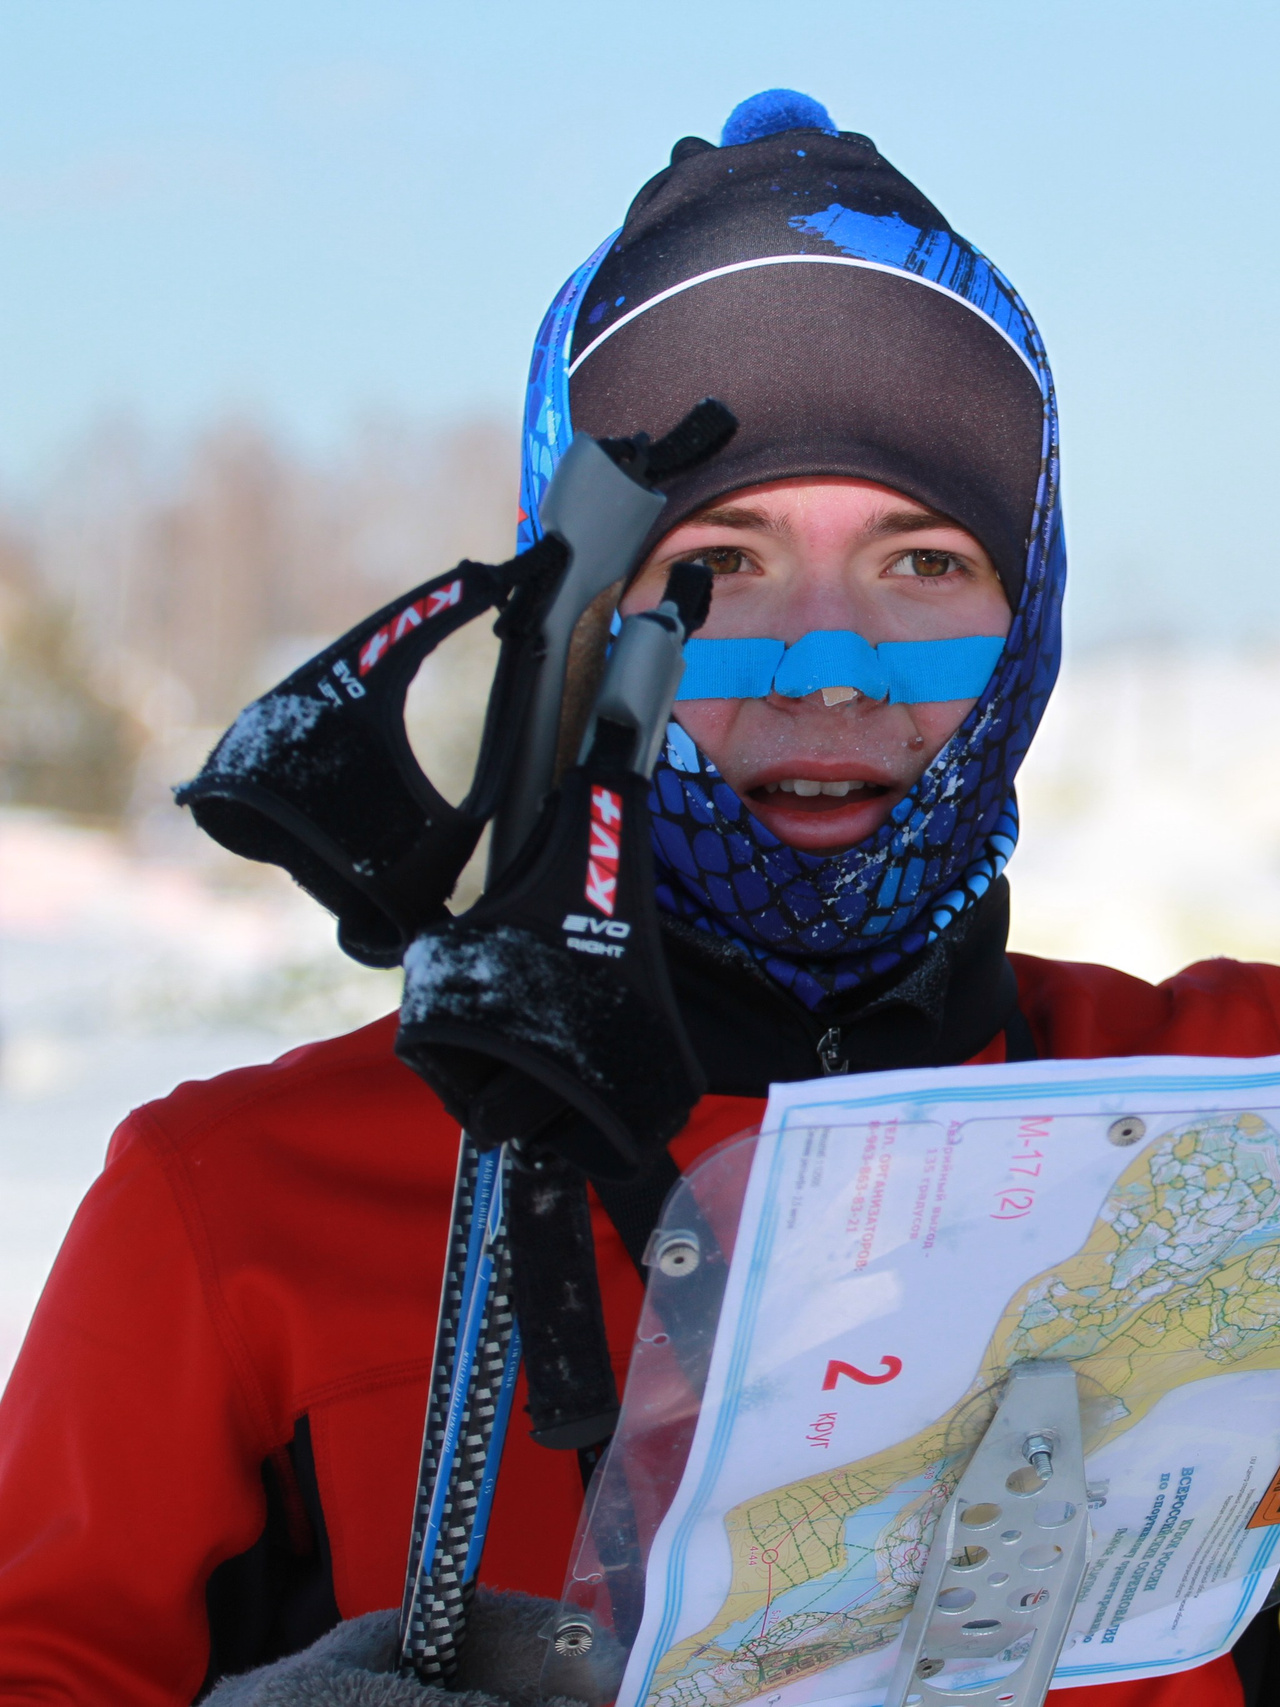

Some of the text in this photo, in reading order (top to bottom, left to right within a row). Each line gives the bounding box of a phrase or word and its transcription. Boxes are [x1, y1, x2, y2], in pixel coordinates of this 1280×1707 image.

[332, 659, 366, 699] EVO
[562, 914, 631, 939] EVO
[566, 937, 625, 959] RIGHT
[936, 1119, 963, 1202] Аварийный
[853, 1118, 898, 1272] ТЕЛ. ОРГАНИЗАТОРОВ:
[909, 1148, 938, 1240] 135 градусов
[990, 1187, 1035, 1221] (2)
[922, 1206, 942, 1250] выход
[821, 1354, 903, 1392] 2
[445, 1410, 458, 1454] ORIGINAL
[460, 1351, 471, 1385] DESIGN
[805, 1412, 838, 1450] круг
[1159, 1472, 1171, 1490] по
[1123, 1493, 1166, 1558] спортивному
[1141, 1466, 1195, 1560] ВСЕРОССИЙСКИЕ
[748, 1545, 759, 1566] 4-44
[1143, 1517, 1195, 1592] КУБОК РОССИИ
[768, 1609, 782, 1625] 5-72
